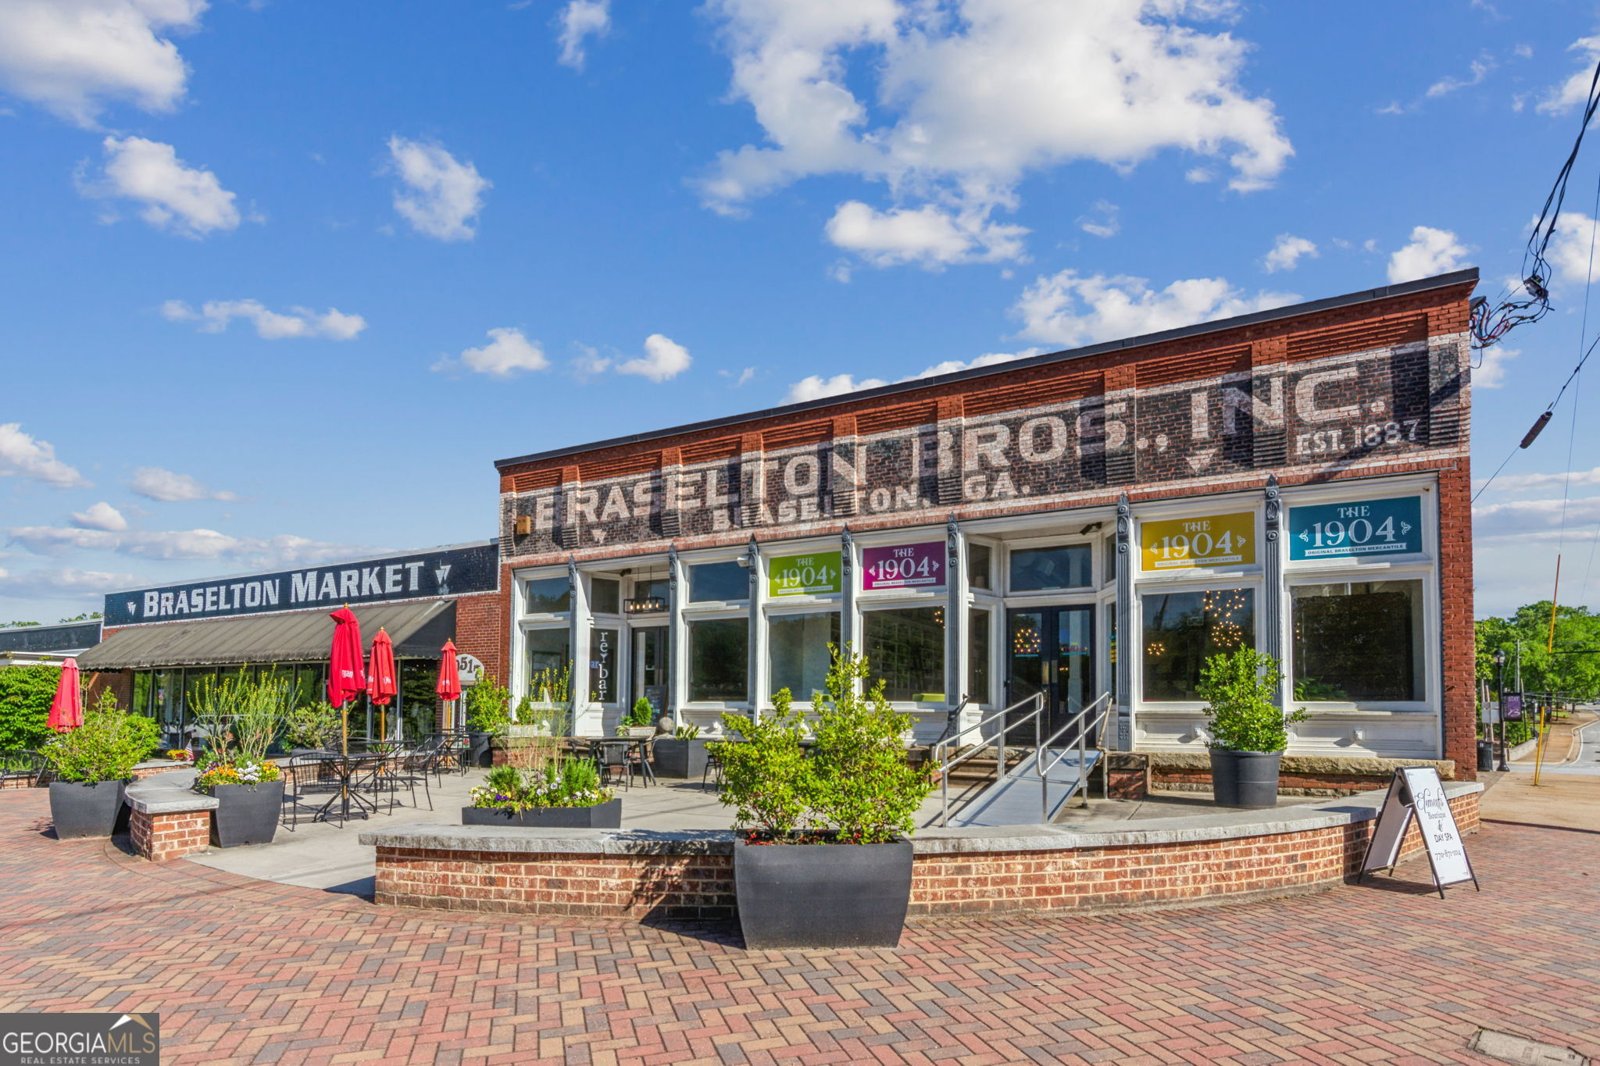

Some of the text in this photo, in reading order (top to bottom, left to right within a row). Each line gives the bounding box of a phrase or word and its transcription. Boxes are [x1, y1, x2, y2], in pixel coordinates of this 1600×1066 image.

[535, 446, 868, 531] BRASELTON
[1191, 366, 1386, 438] INC.
[1296, 418, 1420, 456] EST. 1887
[964, 473, 1030, 500] GA.
[1337, 505, 1370, 519] THE
[1182, 520, 1211, 533] THE
[1312, 515, 1395, 547] 1904
[893, 547, 914, 557] THE
[1161, 530, 1233, 559] 1904
[1307, 544, 1403, 556] ORIGINAL BRASELTON MERCANTILE
[796, 557, 814, 566] THE
[877, 556, 929, 580] 1904
[782, 565, 827, 588] 1904
[143, 561, 424, 618] BRASELTON MARKET
[1444, 832, 1453, 841] SPA
